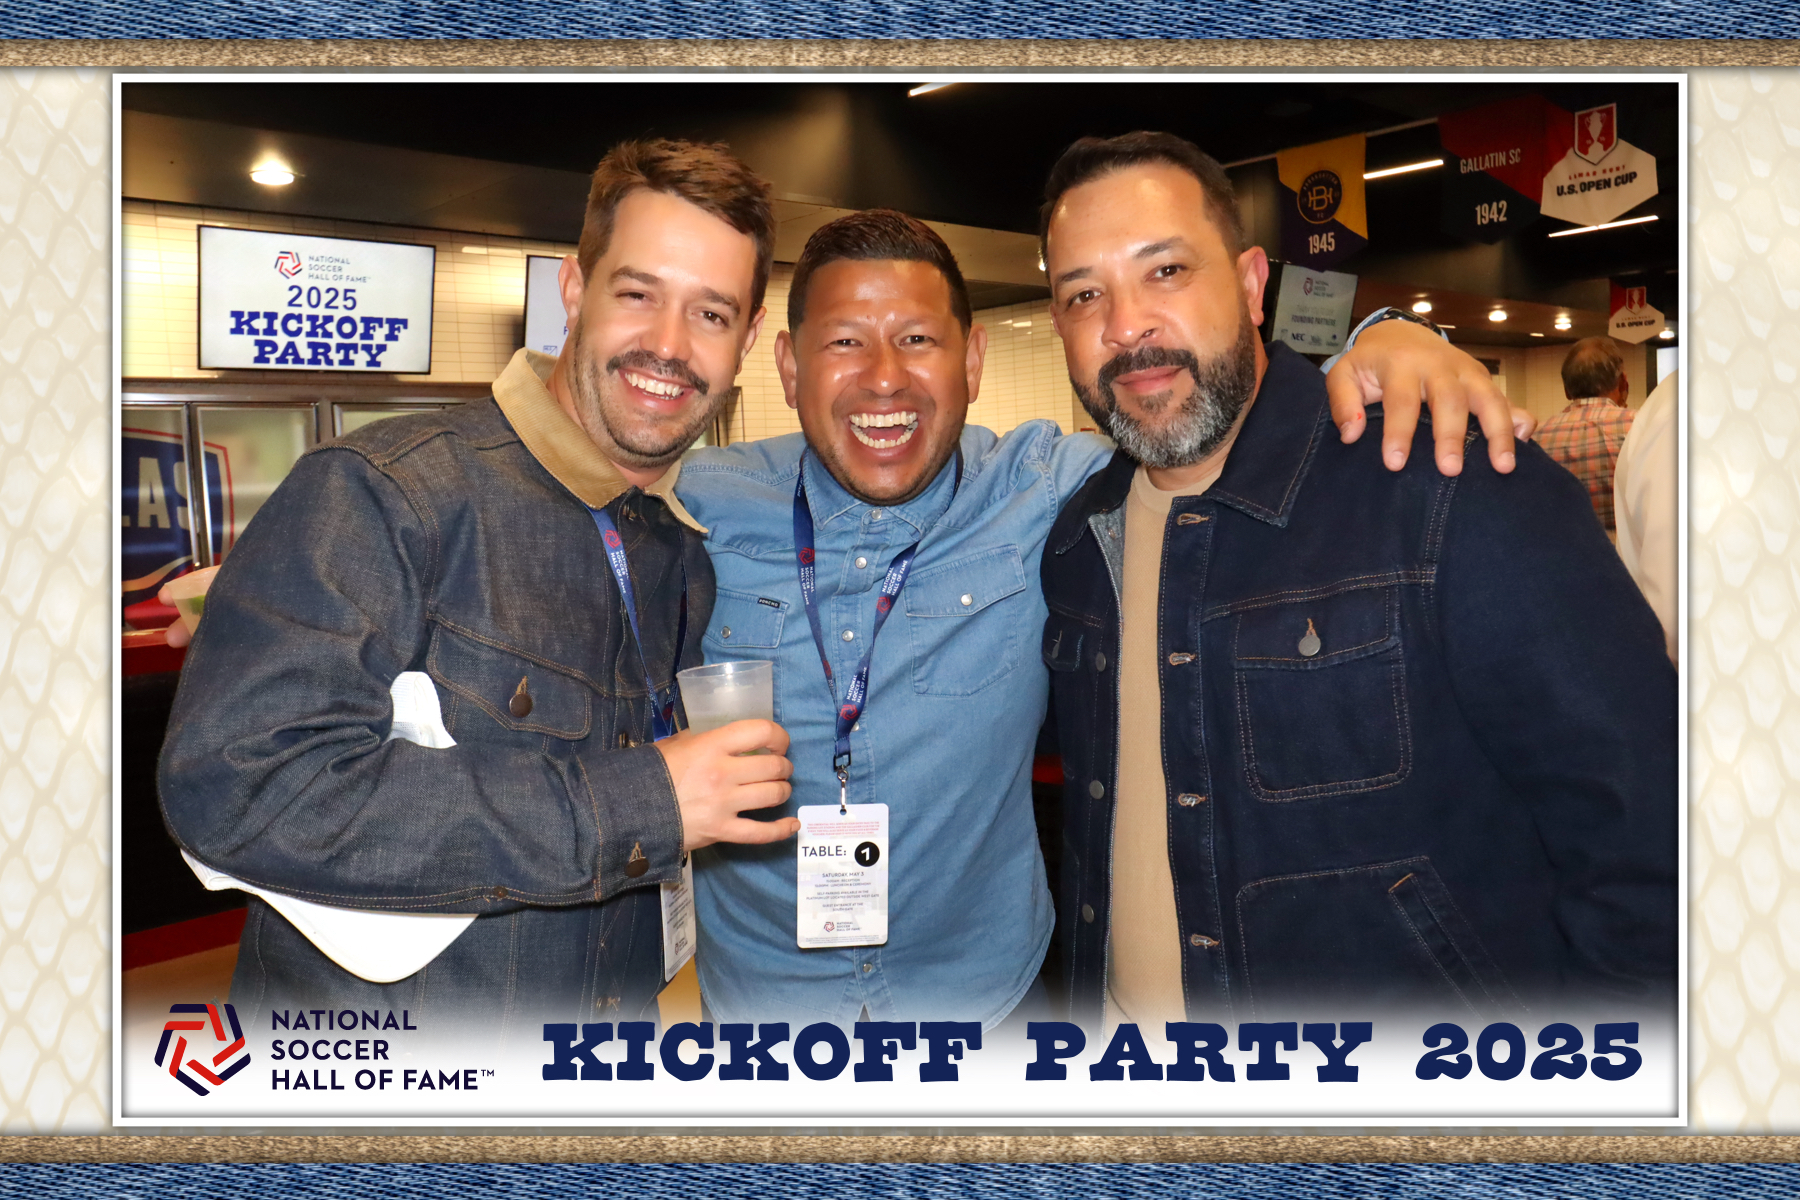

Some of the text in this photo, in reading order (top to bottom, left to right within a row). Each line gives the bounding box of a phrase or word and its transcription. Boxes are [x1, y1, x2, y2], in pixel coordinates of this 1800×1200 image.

[1460, 148, 1521, 174] GALLATIN SC
[1556, 171, 1638, 197] U.S. OPEN CUP
[1475, 200, 1507, 226] 1942
[1308, 232, 1336, 254] 1945
[308, 256, 350, 265] NATIONAL
[308, 264, 343, 272] SOCCER
[308, 273, 330, 281] HALL
[332, 274, 344, 282] OF
[287, 284, 357, 310] 2025
[229, 310, 408, 342] KICKOFF
[1292, 332, 1305, 341] NEC
[253, 339, 388, 368] PARTY
[610, 552, 618, 568] HALL
[616, 569, 622, 577] OF
[616, 551, 626, 576] SOCCER
[620, 550, 630, 580] NATIONAL
[882, 566, 894, 592] NATIONAL
[886, 572, 898, 594] SOCCER
[892, 560, 908, 596] HALL OF FAME
[846, 674, 857, 700] NATIONAL
[852, 680, 860, 702] SOCCER
[860, 681, 865, 689] OF
[802, 846, 846, 857] TABLE:
